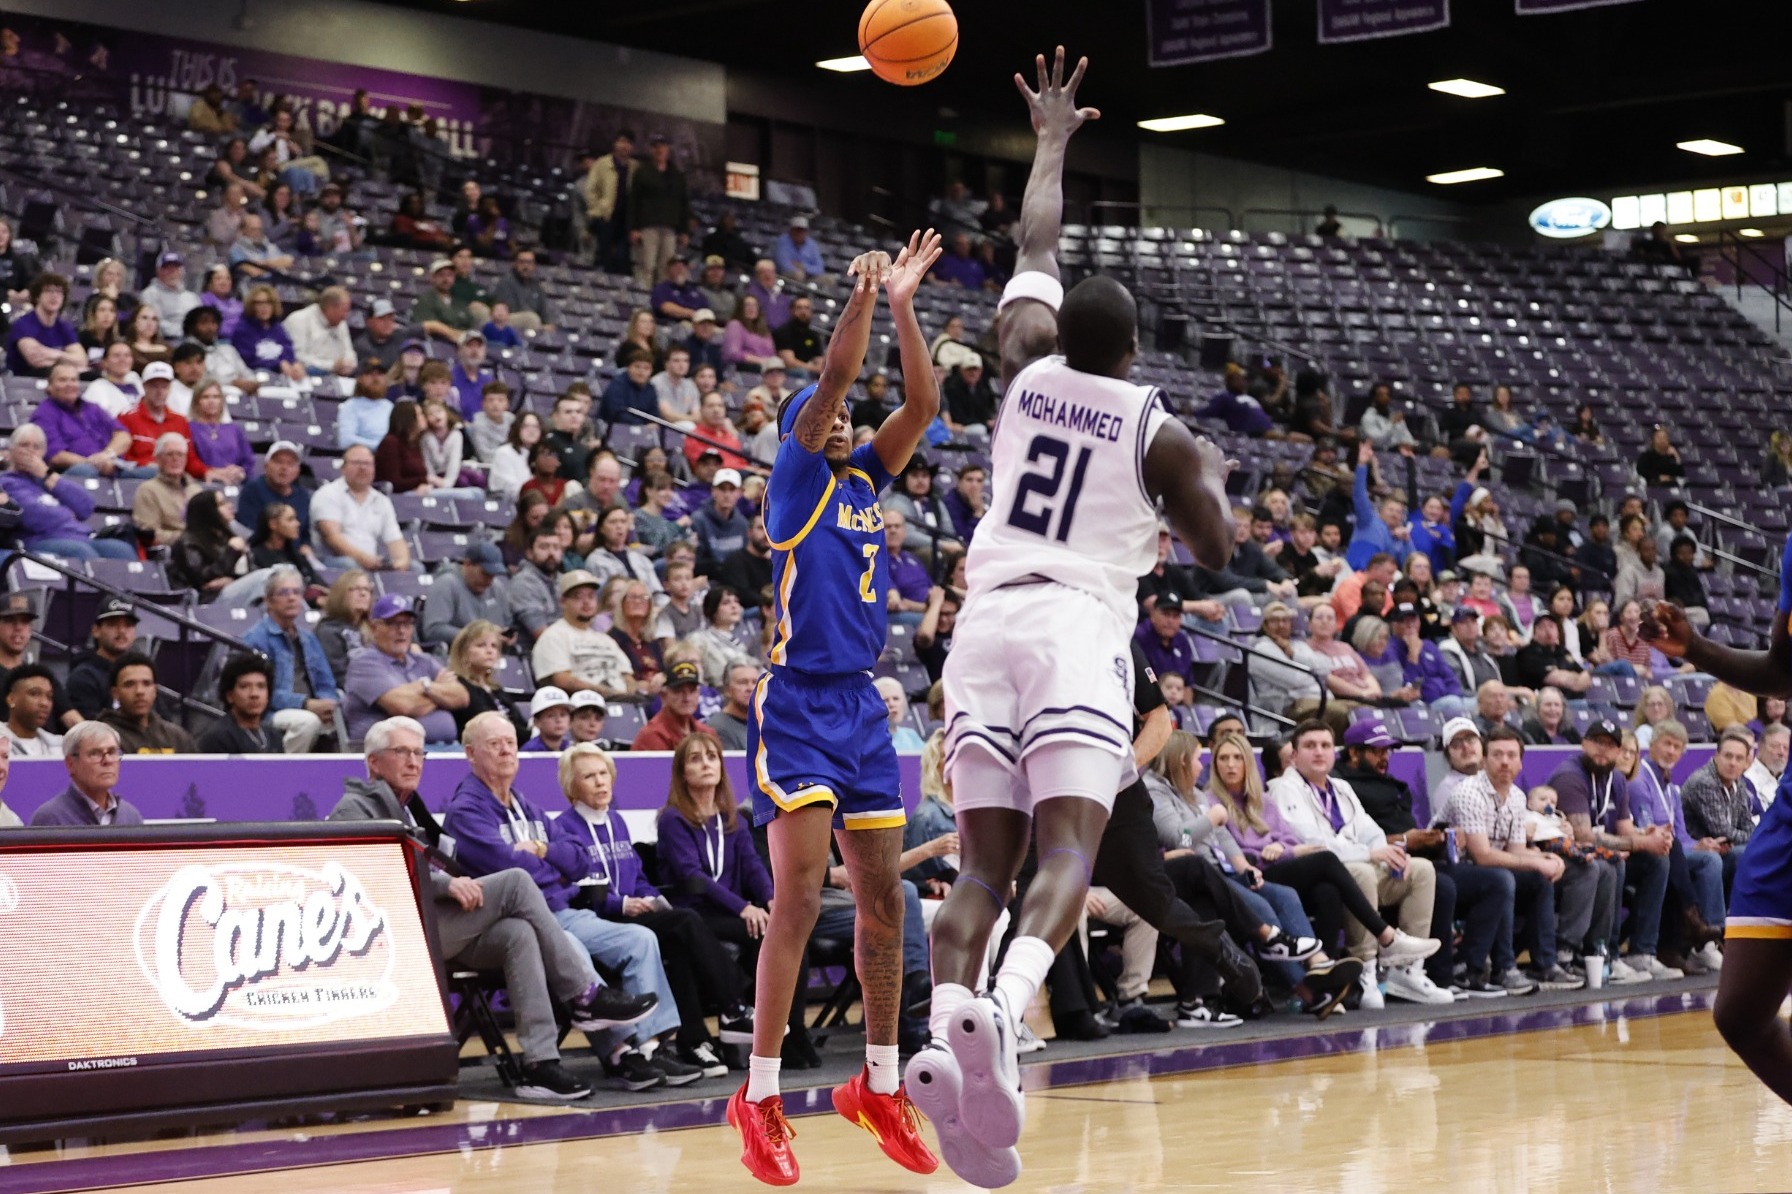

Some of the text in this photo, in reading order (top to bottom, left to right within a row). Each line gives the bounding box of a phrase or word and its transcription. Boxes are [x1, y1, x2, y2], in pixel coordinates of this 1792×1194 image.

[1018, 389, 1123, 443] MOHAMMED
[1007, 433, 1093, 543] 21
[859, 543, 880, 603] 2
[156, 862, 385, 1022] Cane's
[68, 1057, 138, 1071] DAKTRONICS
